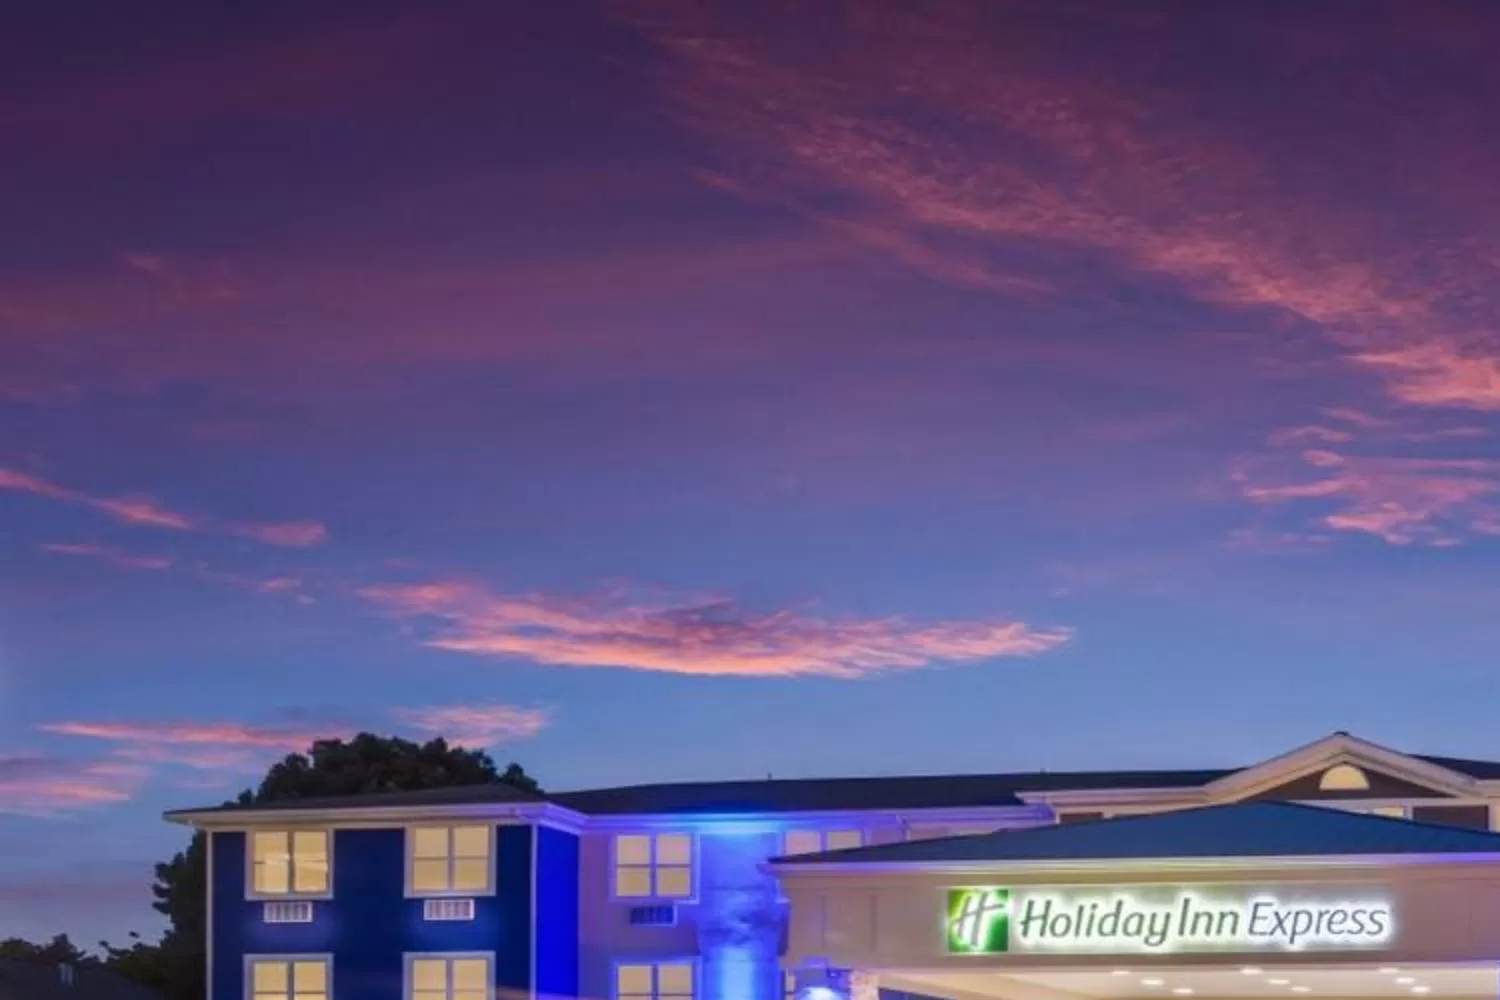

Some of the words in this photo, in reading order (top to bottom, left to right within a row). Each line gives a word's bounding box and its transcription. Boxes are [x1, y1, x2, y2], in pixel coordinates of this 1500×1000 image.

[1019, 900, 1171, 946] Holiday
[1179, 898, 1239, 936] Inn
[1247, 901, 1388, 944] Express
